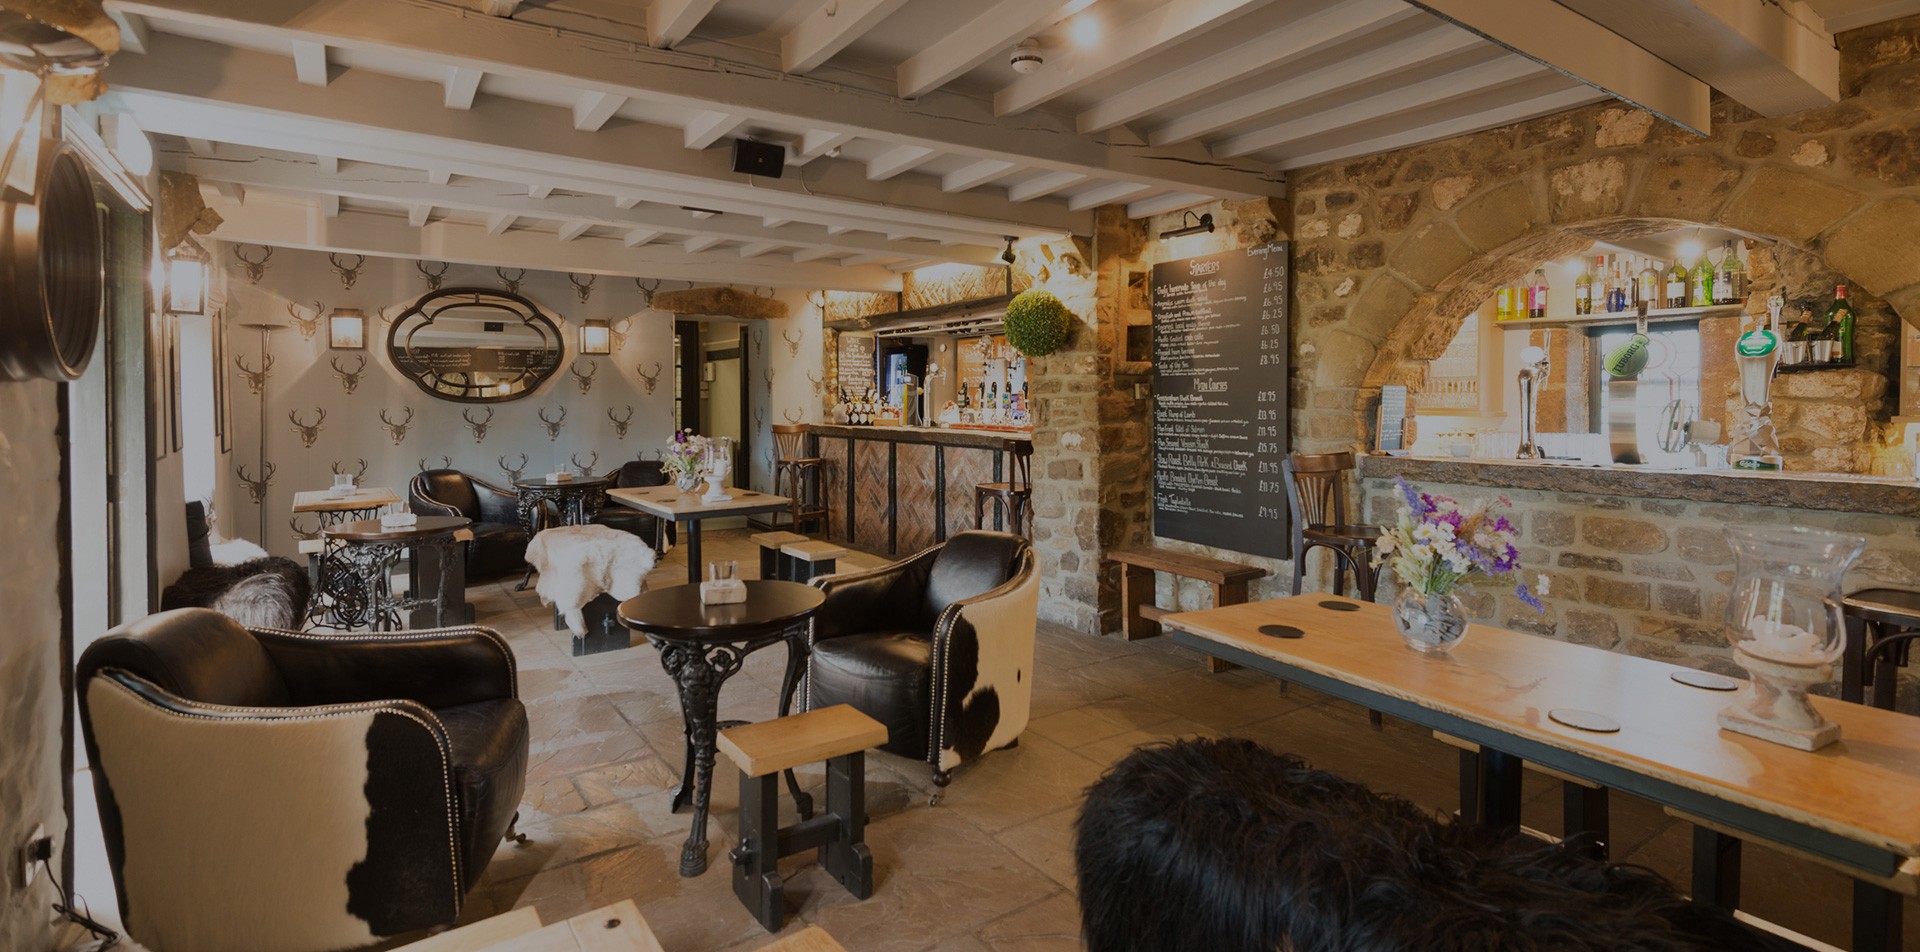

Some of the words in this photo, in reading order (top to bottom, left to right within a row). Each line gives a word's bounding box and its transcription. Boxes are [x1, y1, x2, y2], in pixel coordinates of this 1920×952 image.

[1247, 246, 1268, 260] Evening
[1267, 243, 1283, 253] Menu
[1218, 279, 1226, 290] day
[1260, 354, 1280, 365] £8.95
[1611, 343, 1640, 373] TUBORG
[1257, 391, 1276, 402] £12.95
[1257, 410, 1277, 420] £13.95
[1257, 426, 1277, 437] £11.95
[1257, 442, 1278, 454] £15.75
[1157, 453, 1168, 465] Slow
[1168, 453, 1182, 466] Roast
[1183, 454, 1197, 470] Belly
[1214, 456, 1233, 470] Braised
[1258, 461, 1279, 474] £11.95
[1258, 480, 1280, 493] £11.75
[1258, 505, 1278, 520] £9.95
